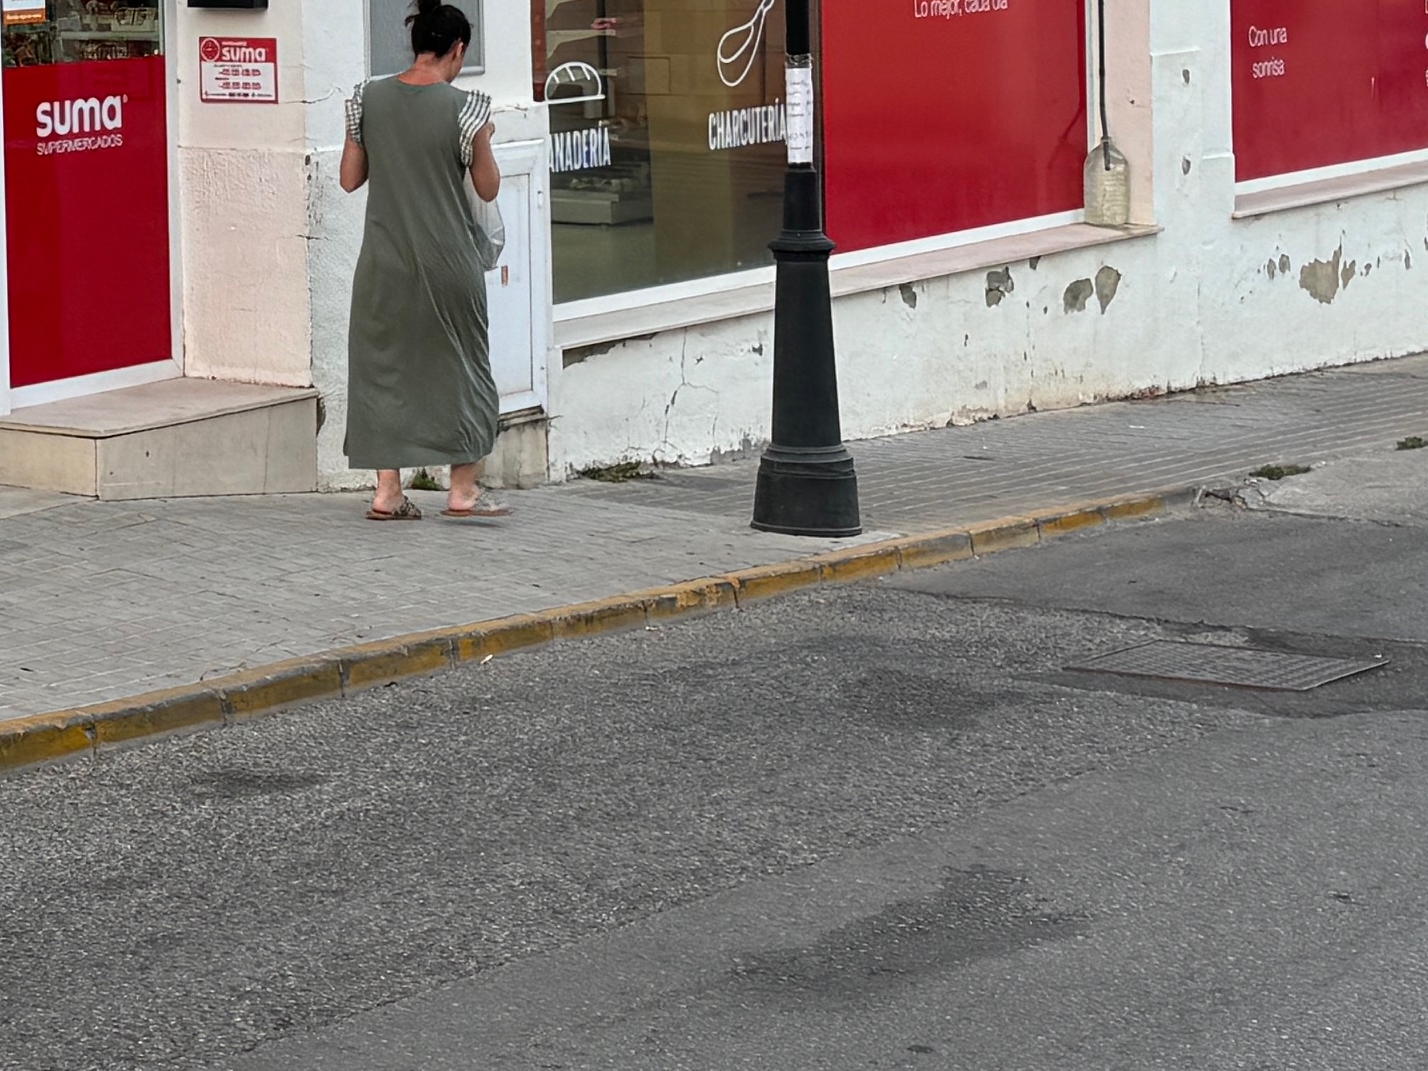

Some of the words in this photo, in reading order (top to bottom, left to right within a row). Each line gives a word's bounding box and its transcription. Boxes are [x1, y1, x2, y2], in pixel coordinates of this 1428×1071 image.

[1248, 25, 1268, 47] Con
[1270, 27, 1288, 45] una
[221, 47, 266, 62] suma
[1252, 56, 1285, 78] sonrisa
[36, 95, 122, 138] suma
[708, 97, 788, 150] CHARCUTERÍA
[37, 134, 123, 155] SUPERMERCADOS
